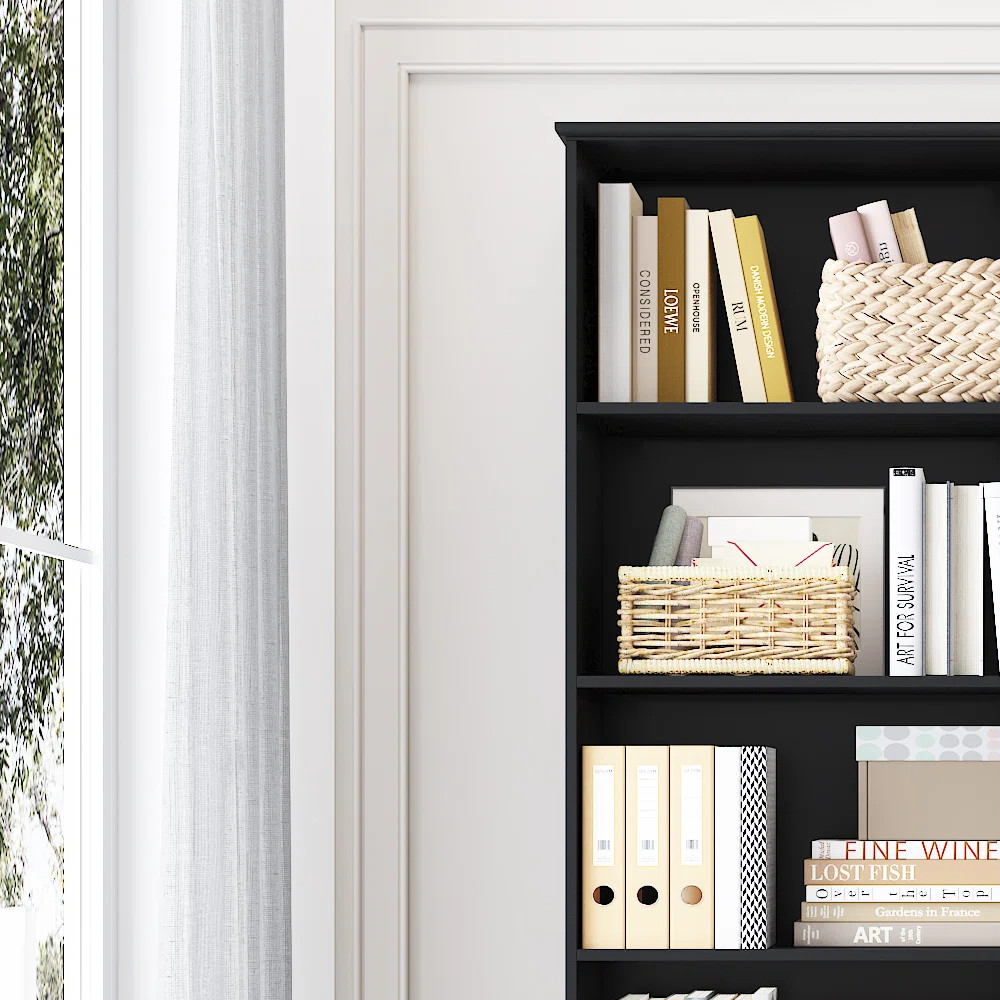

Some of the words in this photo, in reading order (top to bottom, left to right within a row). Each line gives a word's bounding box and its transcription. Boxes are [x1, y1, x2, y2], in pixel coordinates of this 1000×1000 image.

[750, 265, 763, 295] DANISH
[639, 270, 650, 354] CONSIDERED
[664, 289, 679, 334] LOEWE
[692, 282, 700, 333] OPENHOUSE
[755, 295, 769, 329] MODERN
[762, 330, 775, 358] DESIGN
[896, 554, 915, 609] SURVIVAL
[896, 614, 915, 638] FOR
[896, 643, 915, 665] ART
[845, 841, 906, 860] FINE
[810, 864, 864, 881] LOST
[869, 864, 916, 881] FISH
[942, 889, 989, 899] Top
[875, 907, 924, 917] Gardens
[926, 907, 938, 917] in
[941, 907, 981, 917] France
[853, 926, 893, 944] ART
